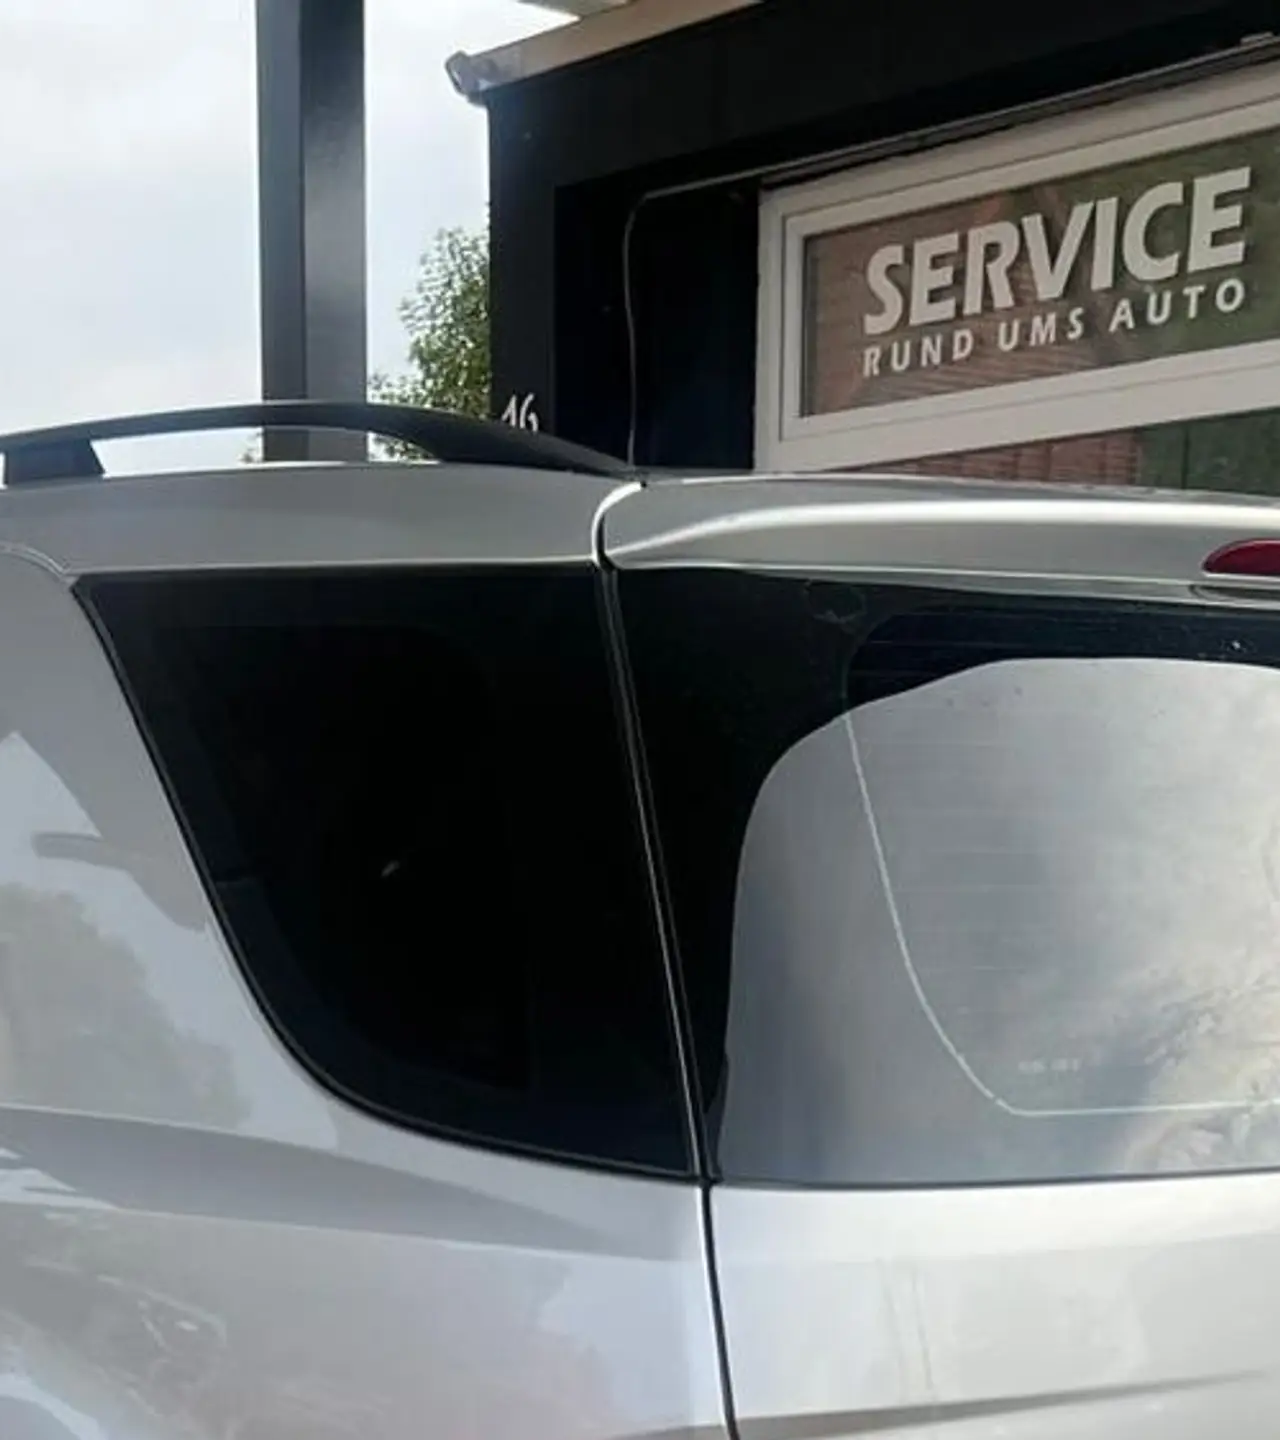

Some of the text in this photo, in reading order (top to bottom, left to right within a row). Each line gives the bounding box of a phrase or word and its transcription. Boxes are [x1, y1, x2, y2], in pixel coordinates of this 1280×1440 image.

[862, 166, 1252, 336] SERVICE
[863, 278, 1246, 378] RUND UMS AUTO
[501, 393, 539, 432] 16
